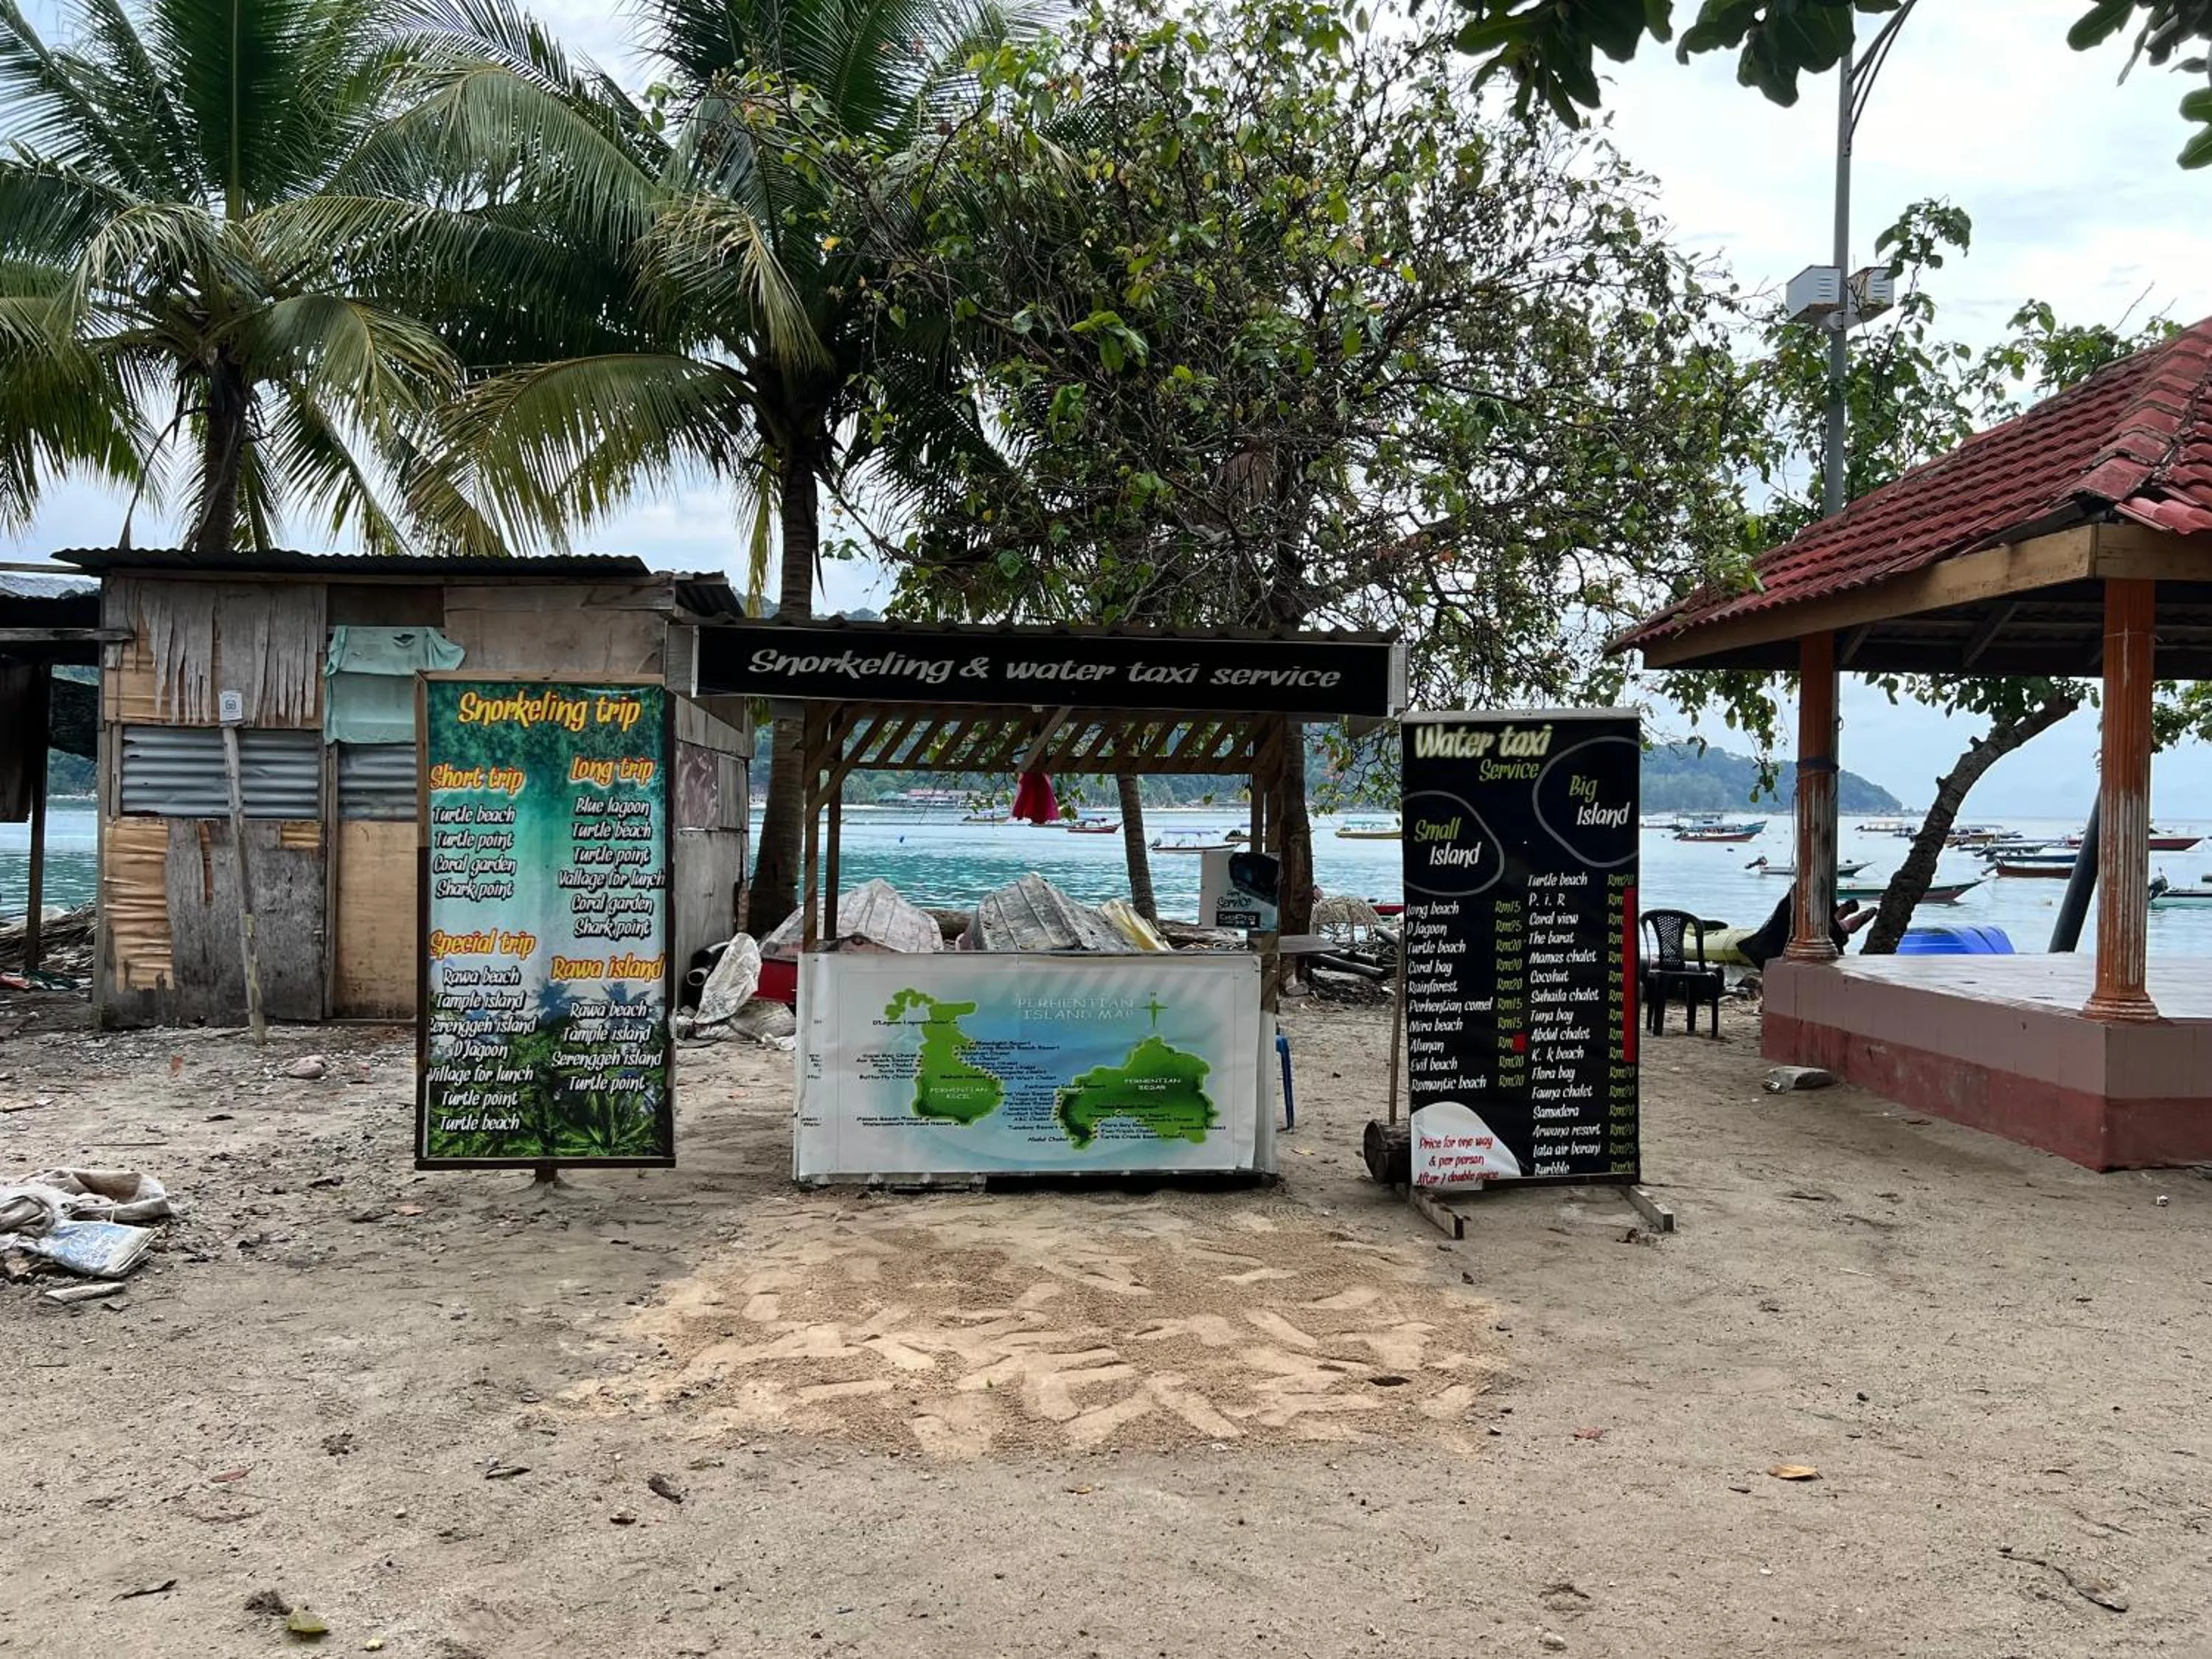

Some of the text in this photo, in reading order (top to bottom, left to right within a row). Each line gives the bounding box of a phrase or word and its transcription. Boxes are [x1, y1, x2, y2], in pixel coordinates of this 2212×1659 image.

[748, 648, 1341, 688] Snorkeling & water taxi service
[457, 689, 641, 733] Snorkeling trip
[1415, 724, 1554, 759] Water taxi
[430, 762, 524, 795] Short trip
[619, 756, 654, 785] trip
[1478, 758, 1540, 782] Service
[1568, 775, 1598, 803] Big
[434, 804, 516, 823] Turtle beach
[575, 796, 650, 818] Blue lagoon
[1576, 801, 1630, 829] Island
[573, 820, 652, 838] Turtle beach
[1414, 817, 1461, 842] Small
[437, 829, 514, 852] Turtle point
[574, 844, 650, 866] Turtle point
[1429, 841, 1483, 869] Island
[435, 855, 517, 876] Coral garden
[608, 869, 629, 887] for
[630, 868, 665, 889] lunch
[1528, 871, 1587, 887] Turtle beach
[437, 878, 514, 901] Shark point
[571, 892, 653, 916] Coral garden
[1430, 900, 1459, 915] beach
[574, 916, 651, 940] Shark point
[1528, 911, 1579, 925] Coral view
[430, 928, 536, 960] Special trip
[1407, 939, 1467, 954] Turtle beach
[1528, 930, 1545, 945] The
[1565, 948, 1598, 963] chalet
[444, 966, 521, 987] Rawa beach
[551, 952, 664, 983] Rawa island
[1408, 959, 1453, 977] Coral bay
[1408, 978, 1458, 995] Rainforest
[1568, 987, 1599, 1002] chalet
[436, 990, 526, 1012] Tample island
[570, 999, 647, 1018] Rawa beach
[494, 1015, 538, 1035] island
[1434, 1017, 1464, 1032] beach
[1530, 1006, 1574, 1025] Tuna bay
[563, 1023, 652, 1045] Tample island
[1559, 1026, 1591, 1040] chalet
[623, 1049, 664, 1068] island
[1555, 1045, 1585, 1060] beach
[1430, 1056, 1458, 1071] beach
[1558, 1064, 1576, 1083] bay
[473, 1064, 493, 1082] for
[495, 1064, 534, 1084] lunch
[568, 1073, 645, 1093] Turtle point
[1411, 1074, 1487, 1092] Romantic beach
[442, 1089, 518, 1110] Turtle point
[1562, 1083, 1593, 1098] chalet
[440, 1113, 520, 1130] Turtle beach
[1571, 1123, 1601, 1136] resort
[1443, 1135, 1456, 1148] for
